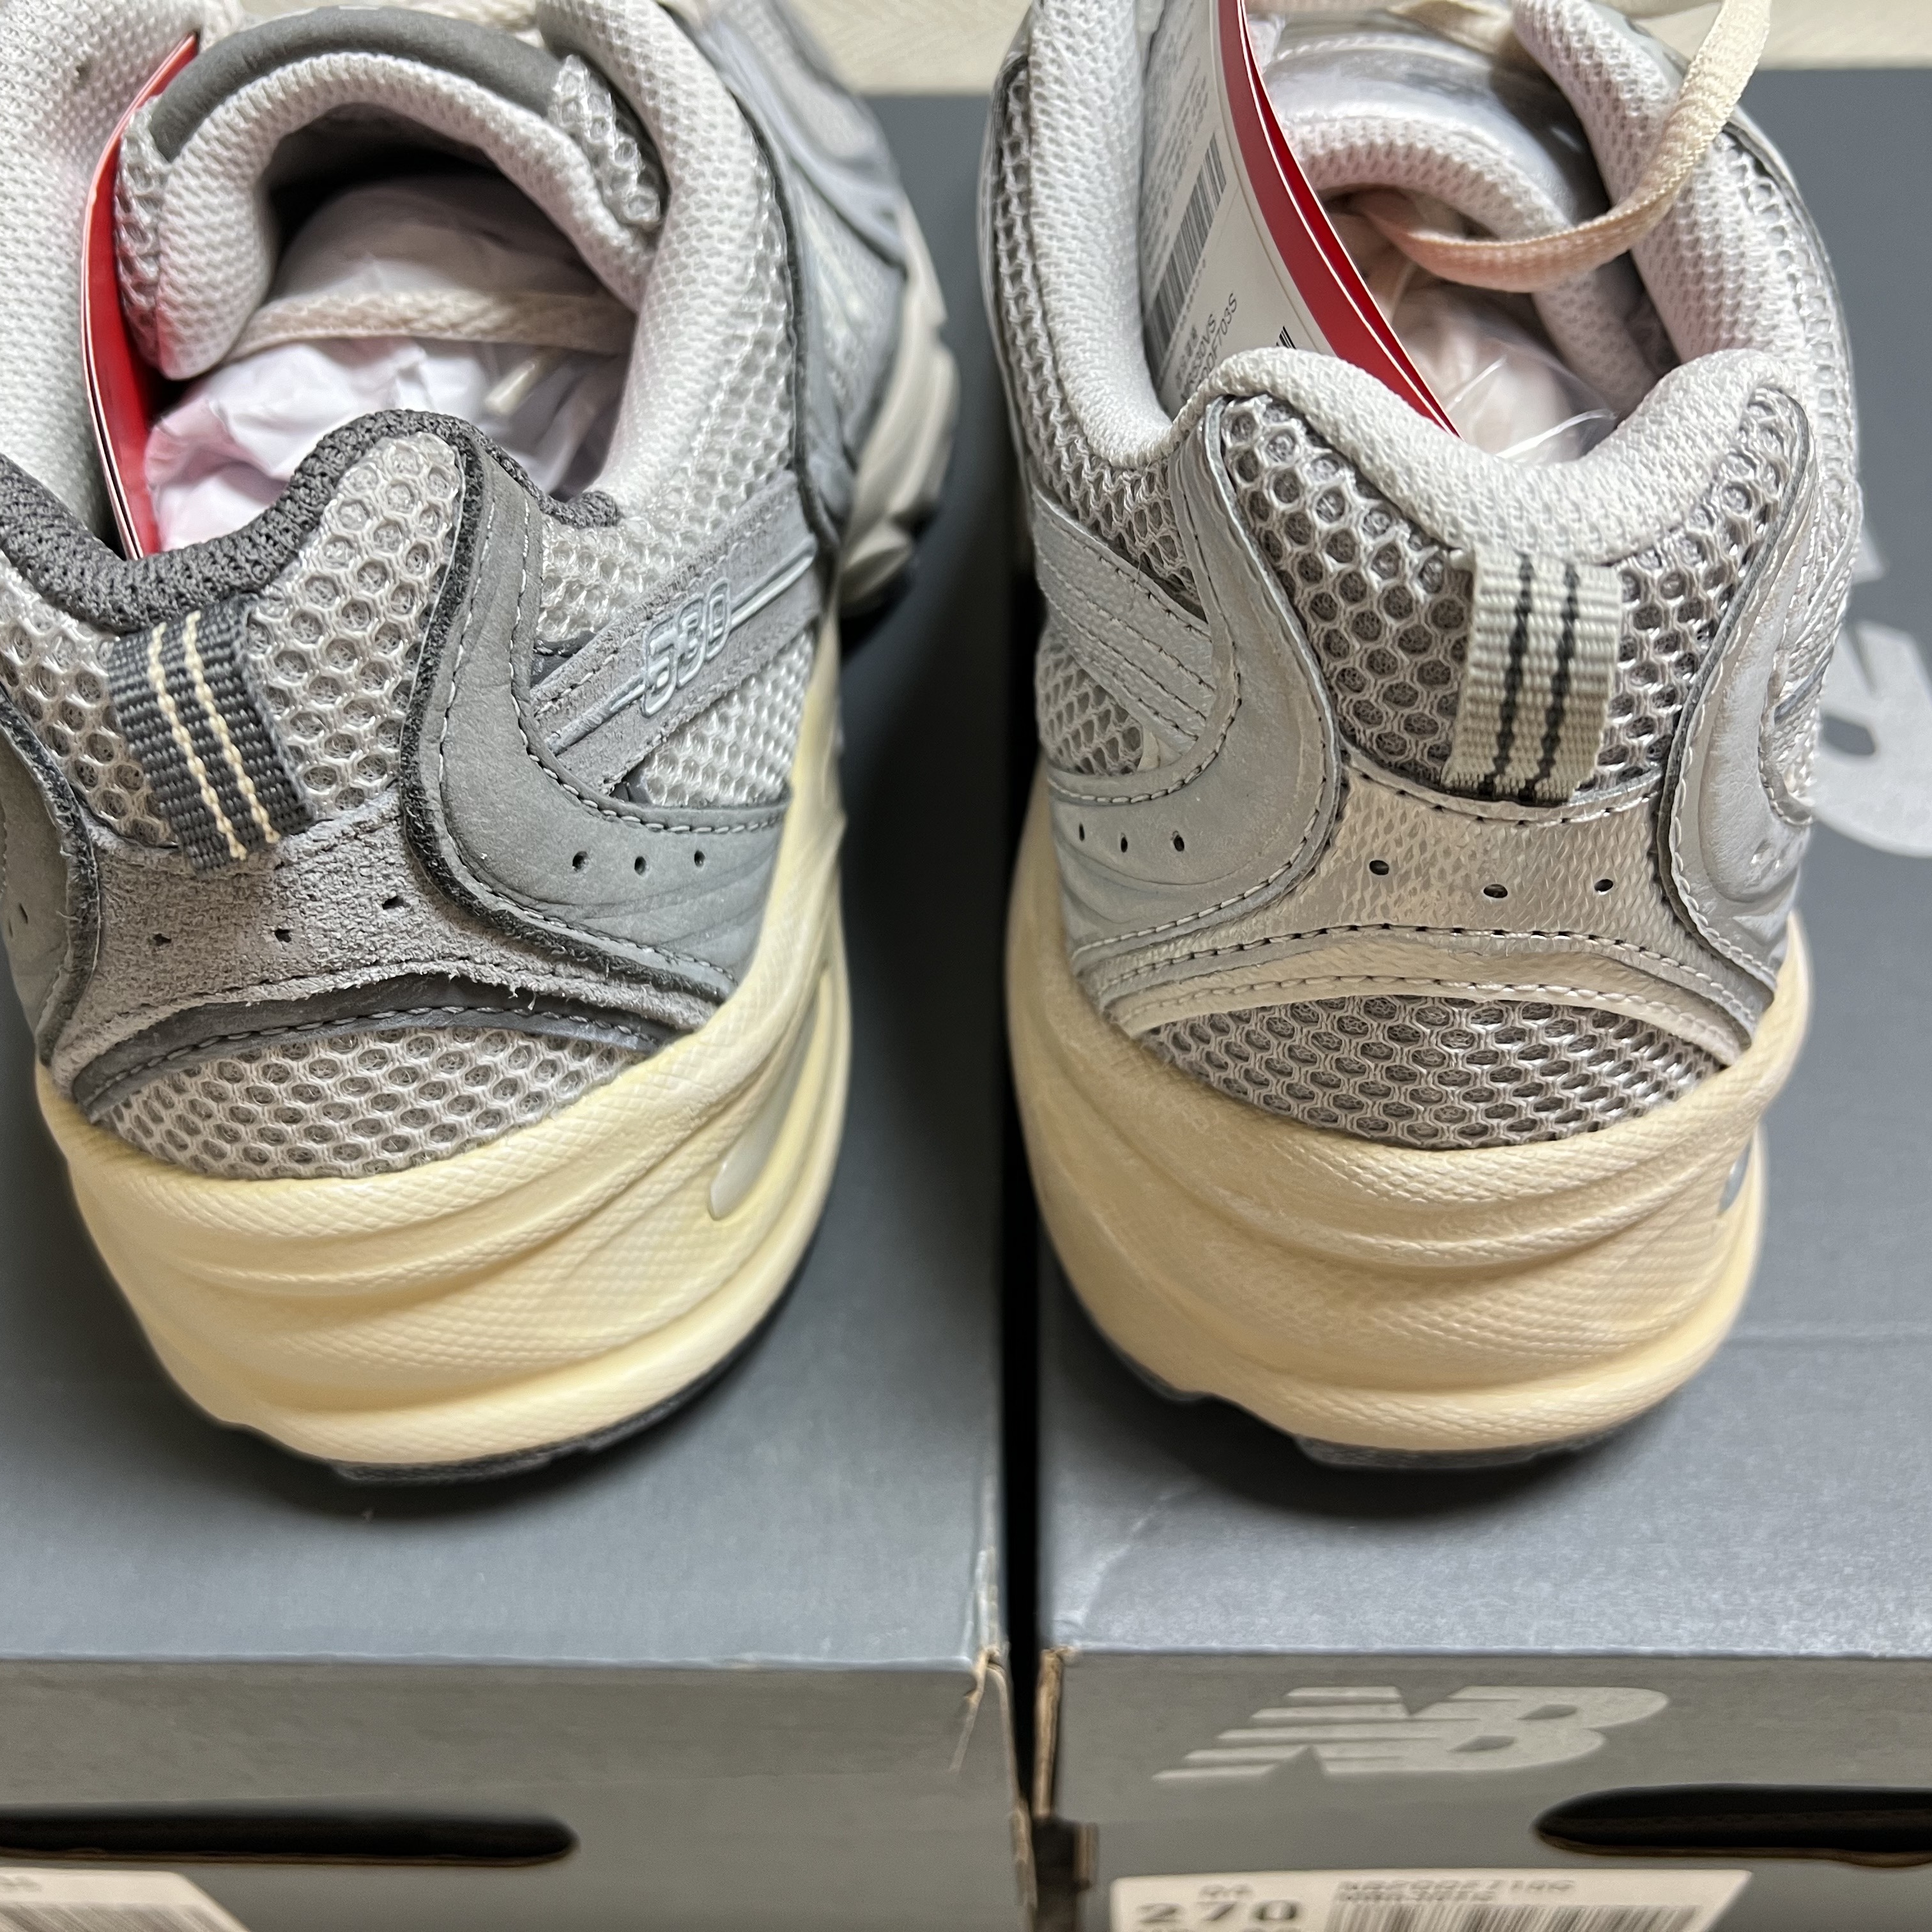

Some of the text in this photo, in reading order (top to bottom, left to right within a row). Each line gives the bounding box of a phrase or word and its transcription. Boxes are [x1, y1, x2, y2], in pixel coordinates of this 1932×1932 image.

[641, 576, 731, 718] 530
[1152, 1685, 1669, 1781] NB
[1136, 1899, 1302, 1925] 270
